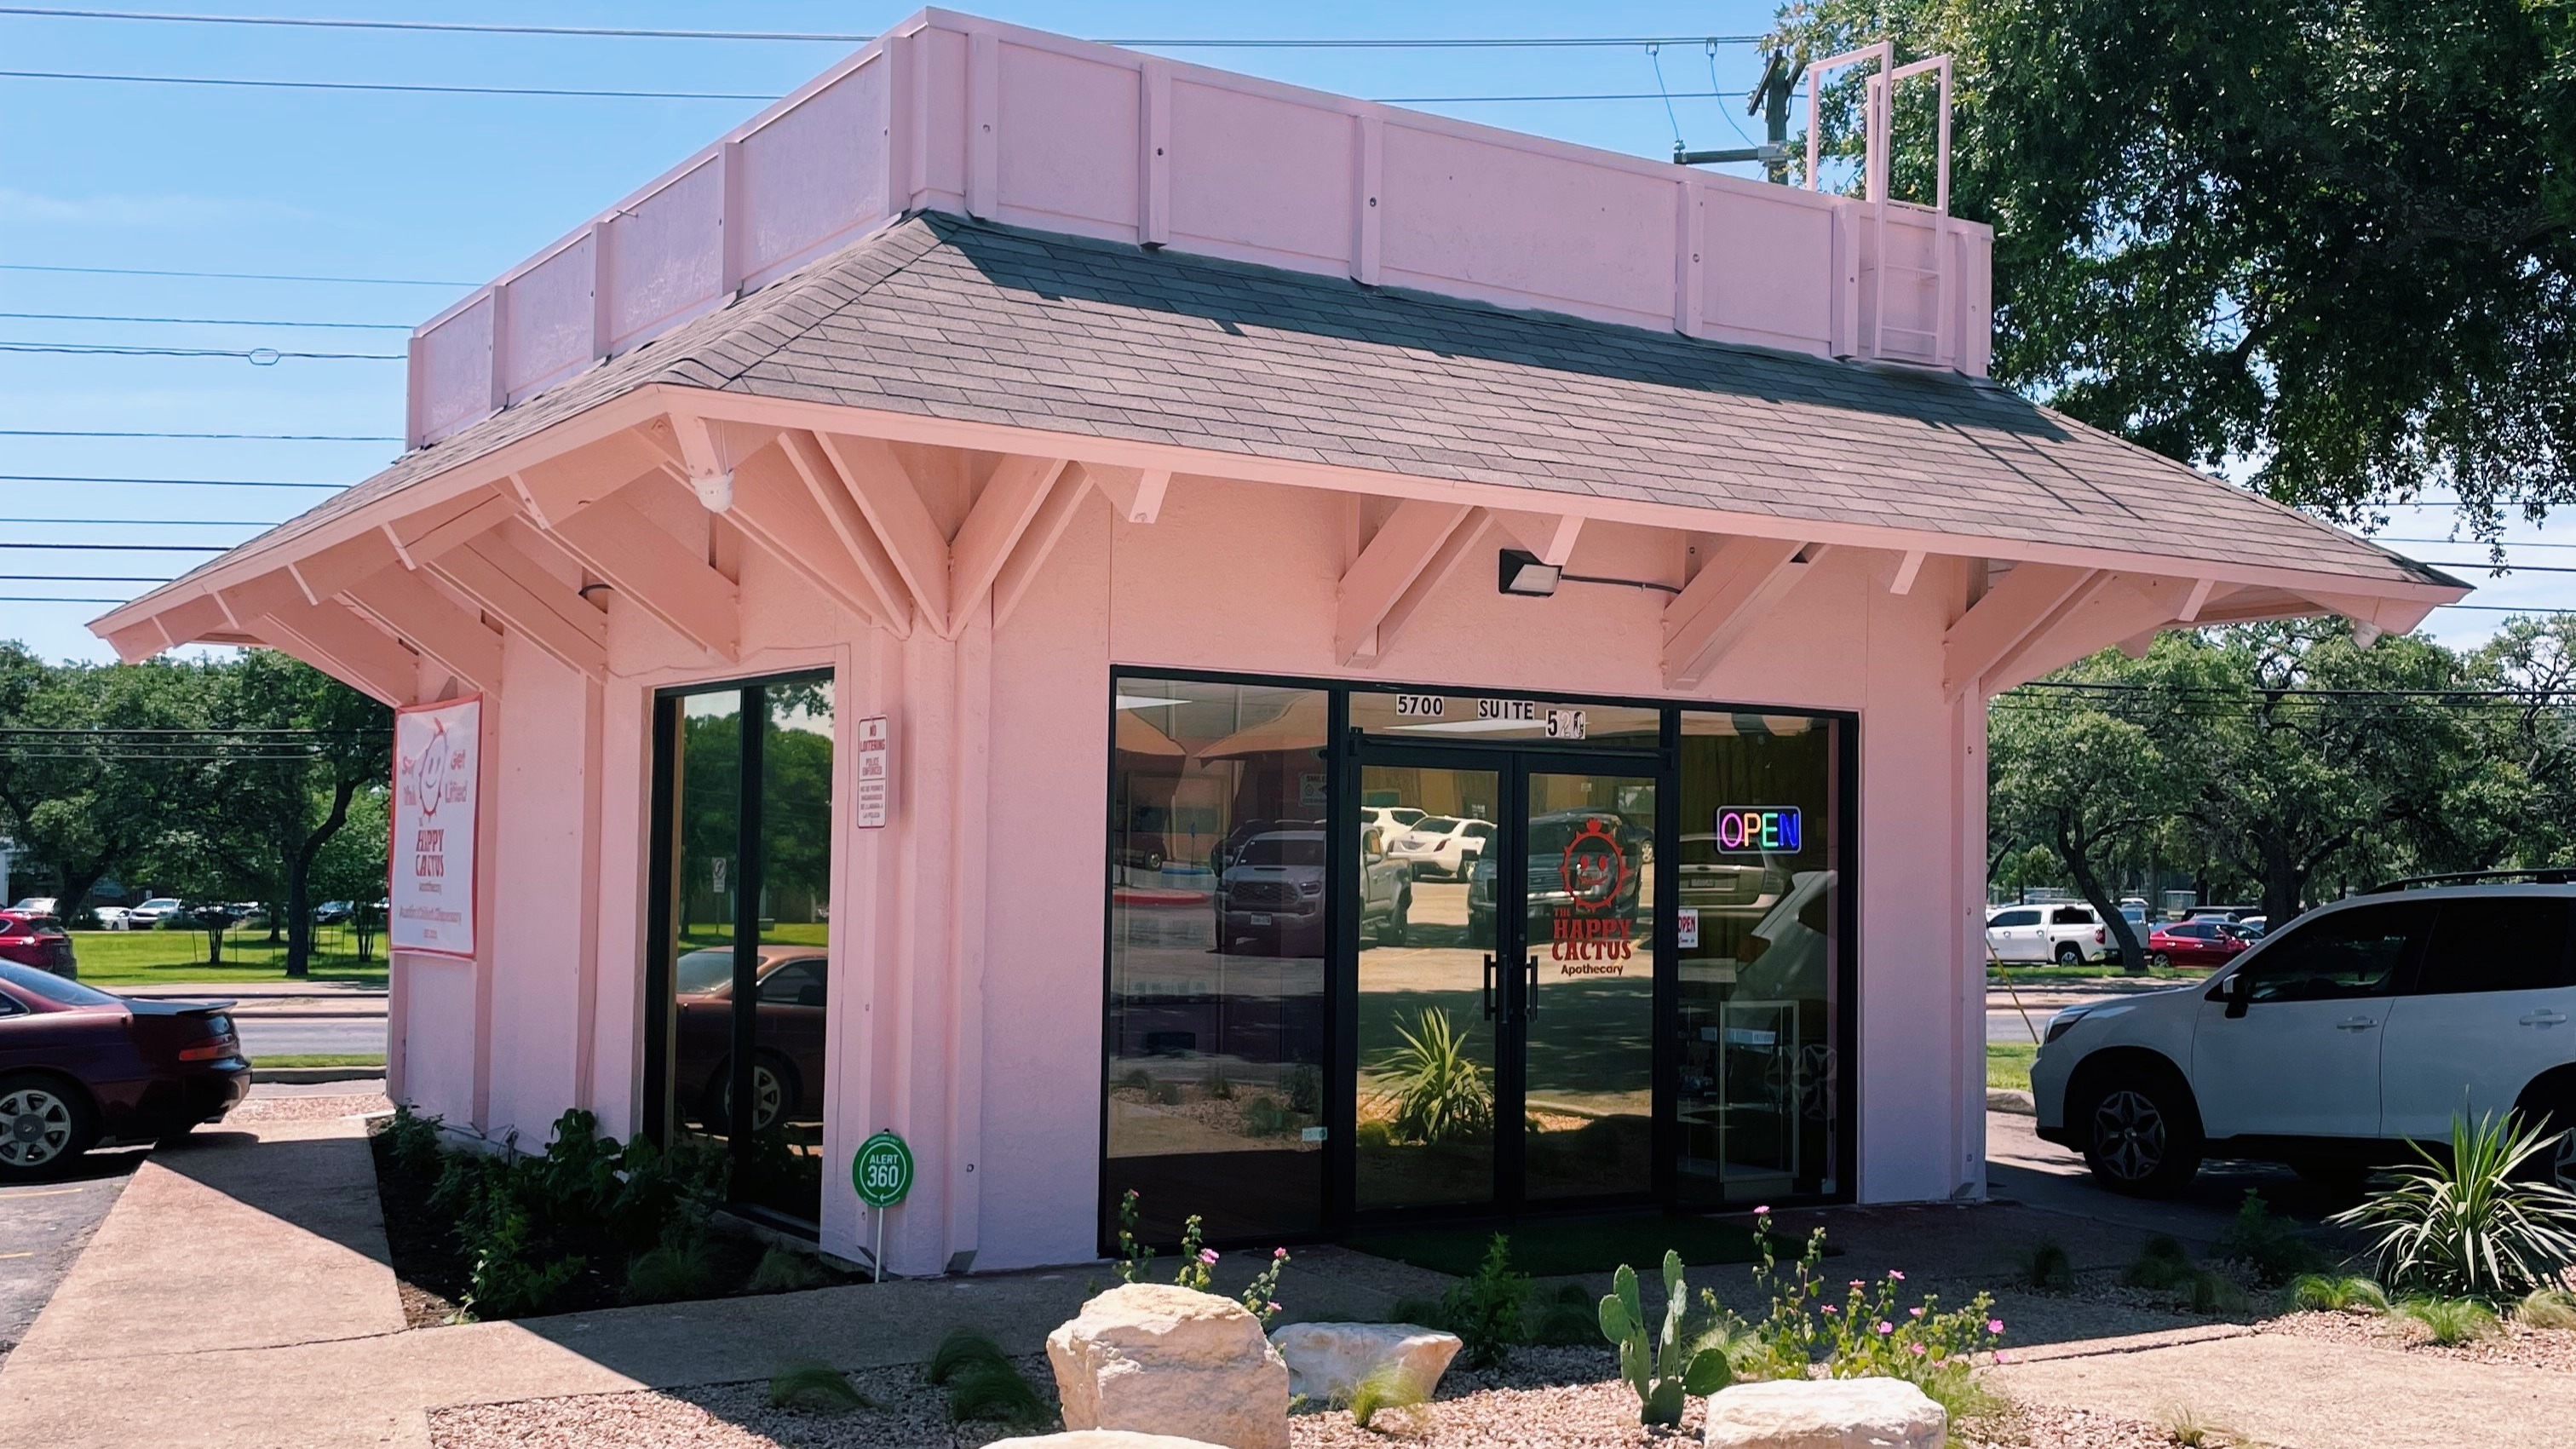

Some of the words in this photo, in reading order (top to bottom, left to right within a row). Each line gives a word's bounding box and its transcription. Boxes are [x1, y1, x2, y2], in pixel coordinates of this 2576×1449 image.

[1397, 696, 1443, 716] 5700
[1479, 700, 1533, 720] SUITE
[870, 725, 877, 737] NO
[860, 739, 885, 752] LOITERING
[416, 829, 444, 852] HAPPY
[1721, 812, 1800, 848] OPEN
[416, 854, 444, 877] CACTUS
[1554, 908, 1571, 917] THE
[1553, 919, 1634, 940] HAPPY
[1552, 940, 1632, 961] CACTUS
[1561, 964, 1624, 975] Apothecary
[869, 1154, 899, 1164] ALERT
[867, 1164, 900, 1187] 360
